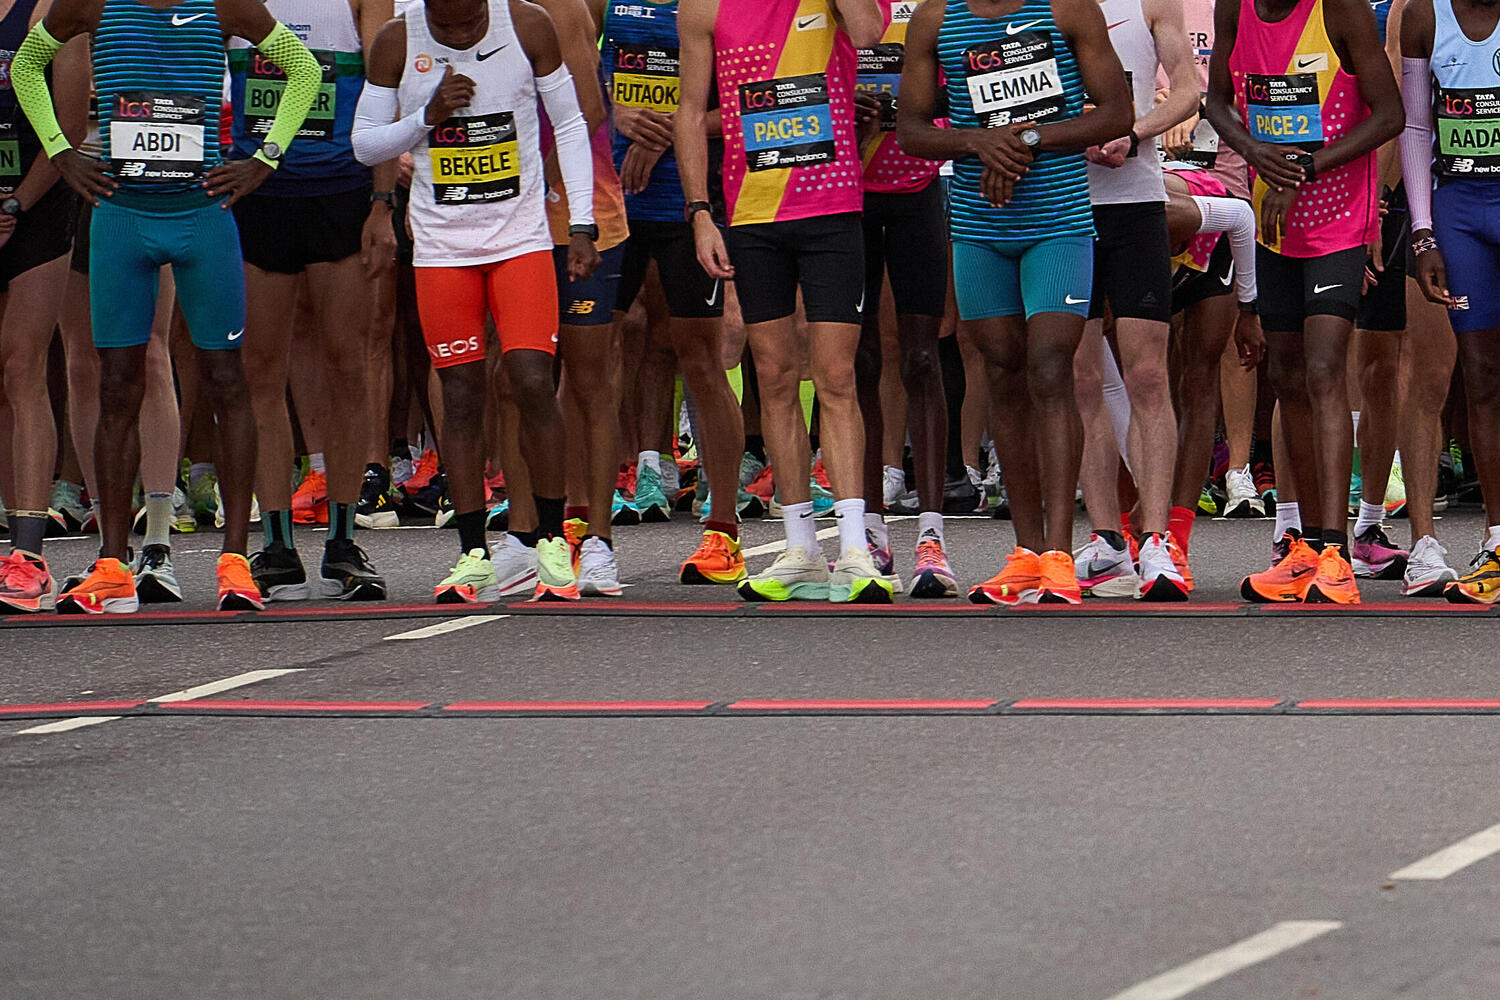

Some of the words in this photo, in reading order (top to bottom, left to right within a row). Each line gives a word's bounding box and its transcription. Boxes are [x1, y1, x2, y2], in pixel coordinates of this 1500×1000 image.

[1001, 41, 1022, 51] TATA
[1002, 42, 1048, 58] CONSULTANCY
[967, 50, 1002, 71] tcs
[1004, 52, 1034, 65] SERVICES
[616, 82, 679, 105] FUTAOK
[776, 86, 822, 98] CONSULTANCY
[979, 71, 1053, 104] LEMMA
[1249, 80, 1269, 101] tcs
[1269, 87, 1313, 95] CONSULTANCY
[745, 90, 775, 109] tcs
[777, 95, 807, 105] SERVICES
[1270, 94, 1298, 102] SERVICES
[1445, 94, 1473, 115] tcs
[1028, 106, 1059, 120] balance
[434, 126, 466, 143] tcs
[753, 117, 805, 143] PACE
[807, 115, 820, 135] 3
[1256, 114, 1295, 136] PACE
[1296, 115, 1310, 135] 2
[132, 132, 181, 152] ABDI
[440, 151, 512, 176] BEKELE
[427, 336, 479, 358] NEOS
